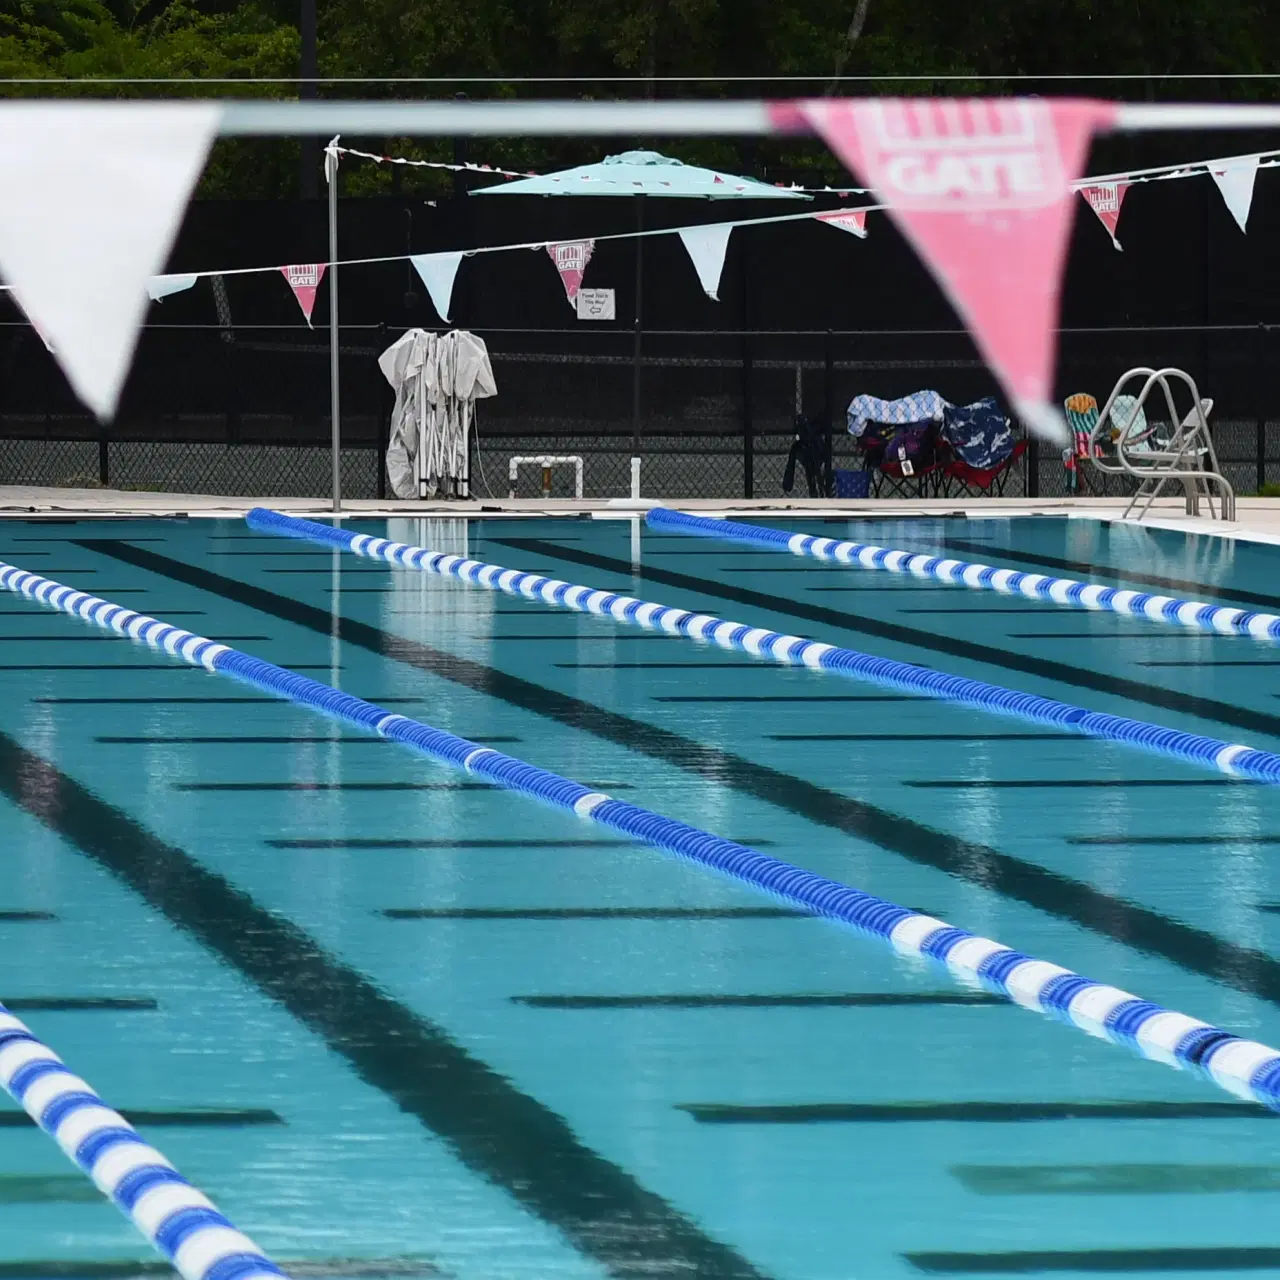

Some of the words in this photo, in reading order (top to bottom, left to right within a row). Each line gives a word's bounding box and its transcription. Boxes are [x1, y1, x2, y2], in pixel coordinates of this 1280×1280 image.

[889, 152, 1047, 193] GATE
[558, 260, 583, 269] GATE
[290, 276, 316, 285] GATE
